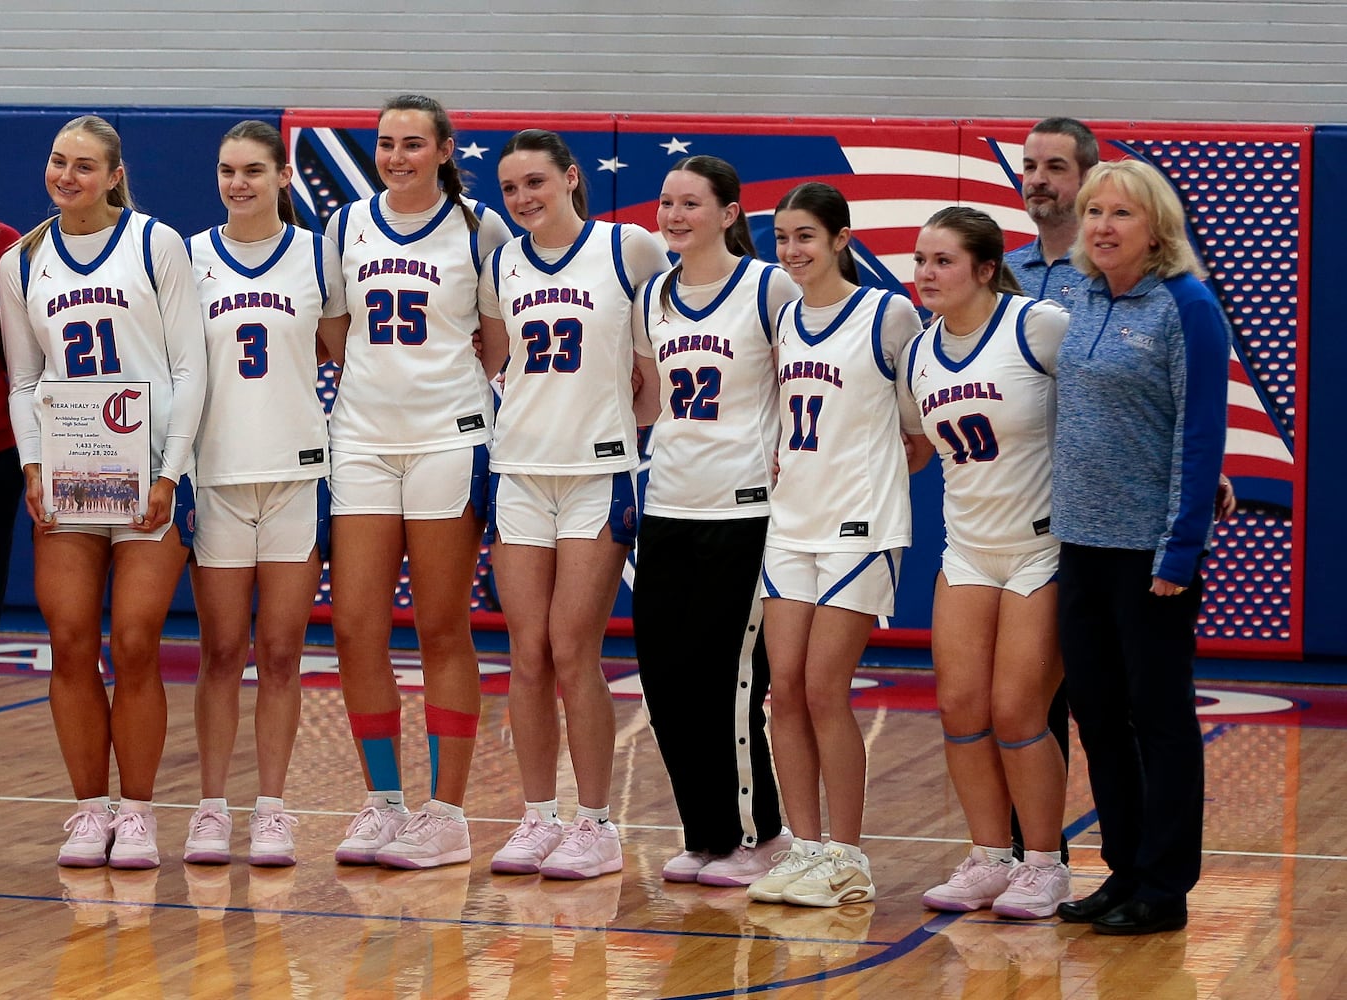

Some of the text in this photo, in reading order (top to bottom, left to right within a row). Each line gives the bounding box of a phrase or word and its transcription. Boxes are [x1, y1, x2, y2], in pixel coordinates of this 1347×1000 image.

[357, 258, 441, 286] CARROLL
[47, 286, 129, 318] CARROLL
[209, 291, 296, 320] CARROLL
[364, 288, 430, 346] 25
[512, 287, 594, 317] CARROLL
[62, 317, 122, 379] 21
[235, 322, 269, 380] 3
[521, 317, 583, 375] 23
[658, 334, 734, 364] CARROLL
[668, 366, 722, 421] 22
[779, 360, 844, 390] CARROLL
[102, 388, 143, 434] C
[788, 394, 824, 452] 11
[921, 382, 1004, 418] CARROLL
[936, 412, 1000, 465] 10
